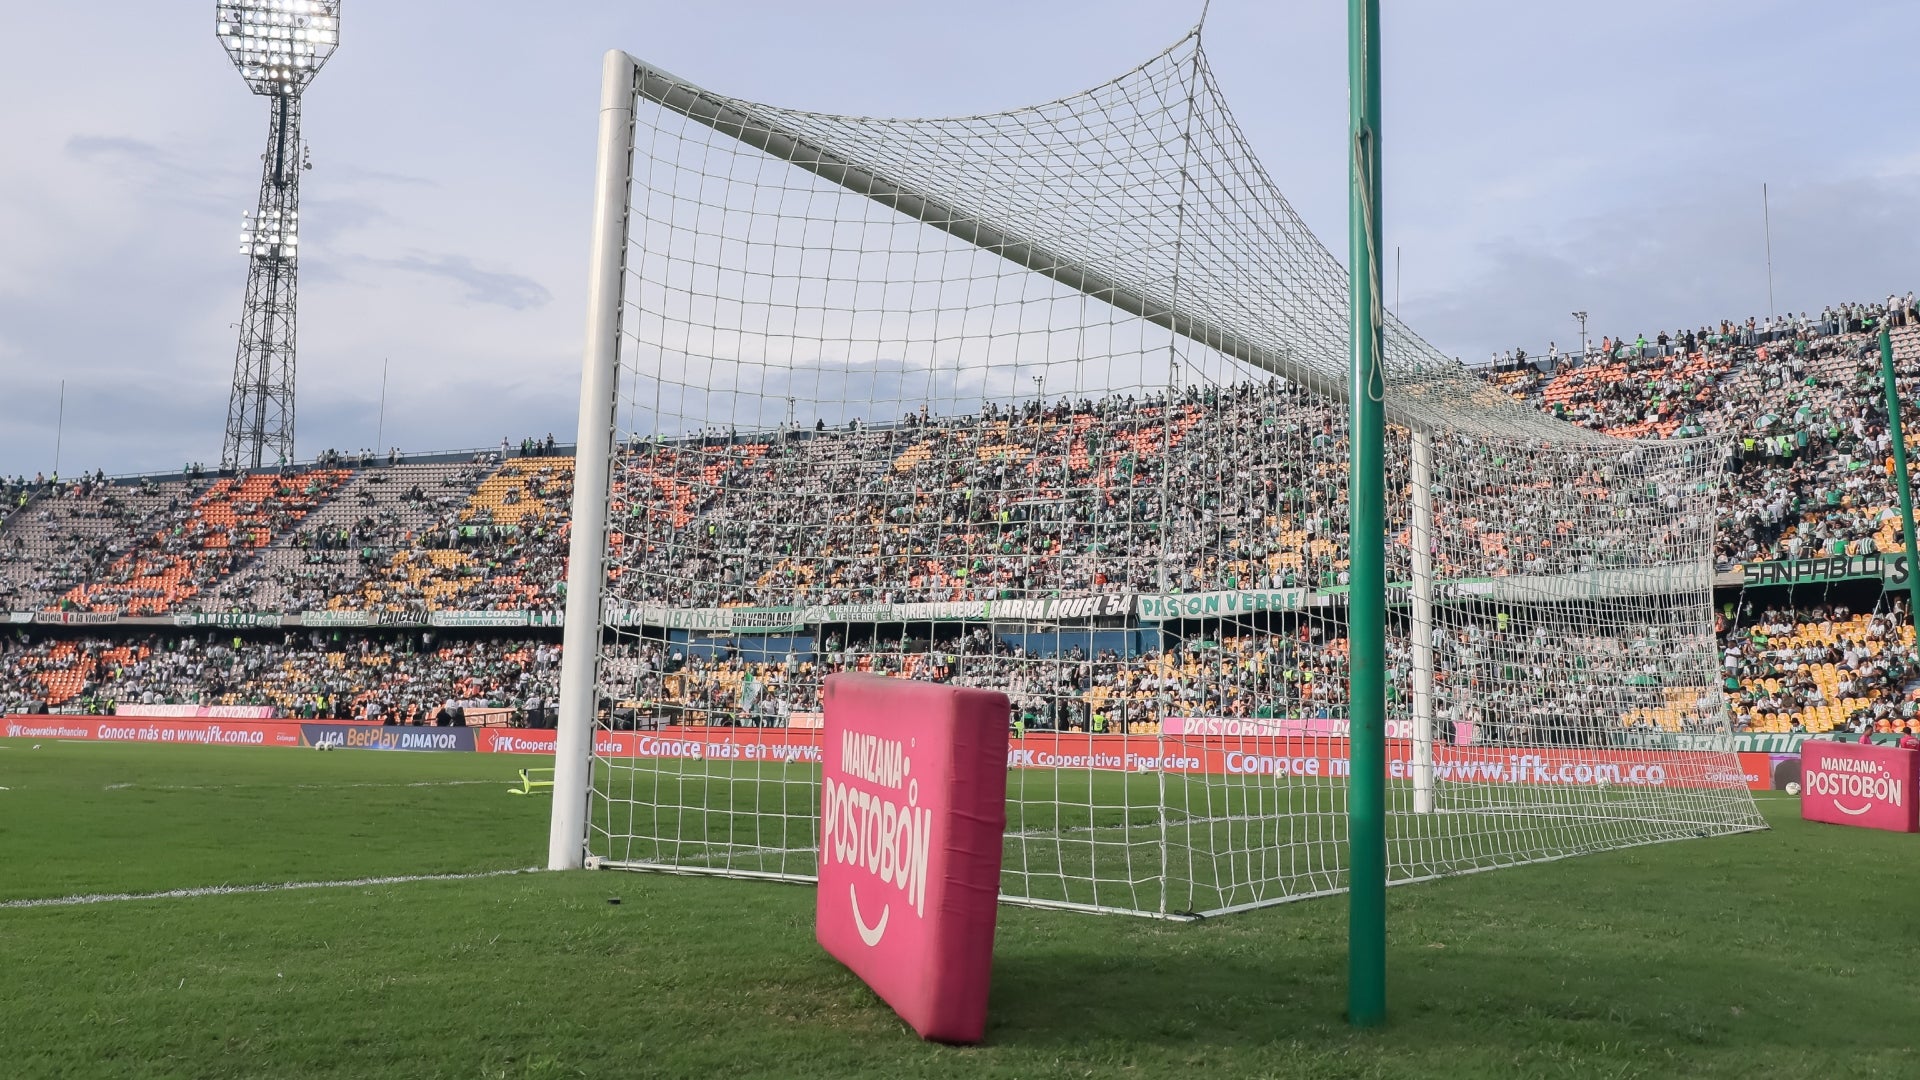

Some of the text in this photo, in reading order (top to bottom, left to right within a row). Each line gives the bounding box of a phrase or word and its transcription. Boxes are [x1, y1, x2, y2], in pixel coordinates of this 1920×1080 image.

[1046, 595, 1103, 619] AQUEL
[1105, 594, 1133, 616] 54
[1225, 590, 1300, 612] VERDE
[76, 612, 84, 622] la
[86, 612, 117, 623] violencia
[198, 613, 256, 625] AMISTAD
[308, 609, 364, 620] PAZ VERDE
[469, 610, 482, 618] DE
[486, 610, 520, 618] COPAS
[22, 726, 58, 738] Cooperativa
[58, 727, 88, 737] Financiera
[98, 724, 264, 744] Conoce más en www.jfk.com.co
[320, 728, 456, 749] LIGA BetPlay DIMAYOR
[639, 737, 700, 758] Conoce
[707, 738, 739, 758] más
[745, 744, 766, 759] en
[842, 729, 902, 790] MANZANA
[1037, 752, 1121, 770] Cooperativa
[1126, 752, 1200, 769] Financiera
[1226, 751, 1320, 774] Conoce
[1821, 756, 1877, 775] MANZANA
